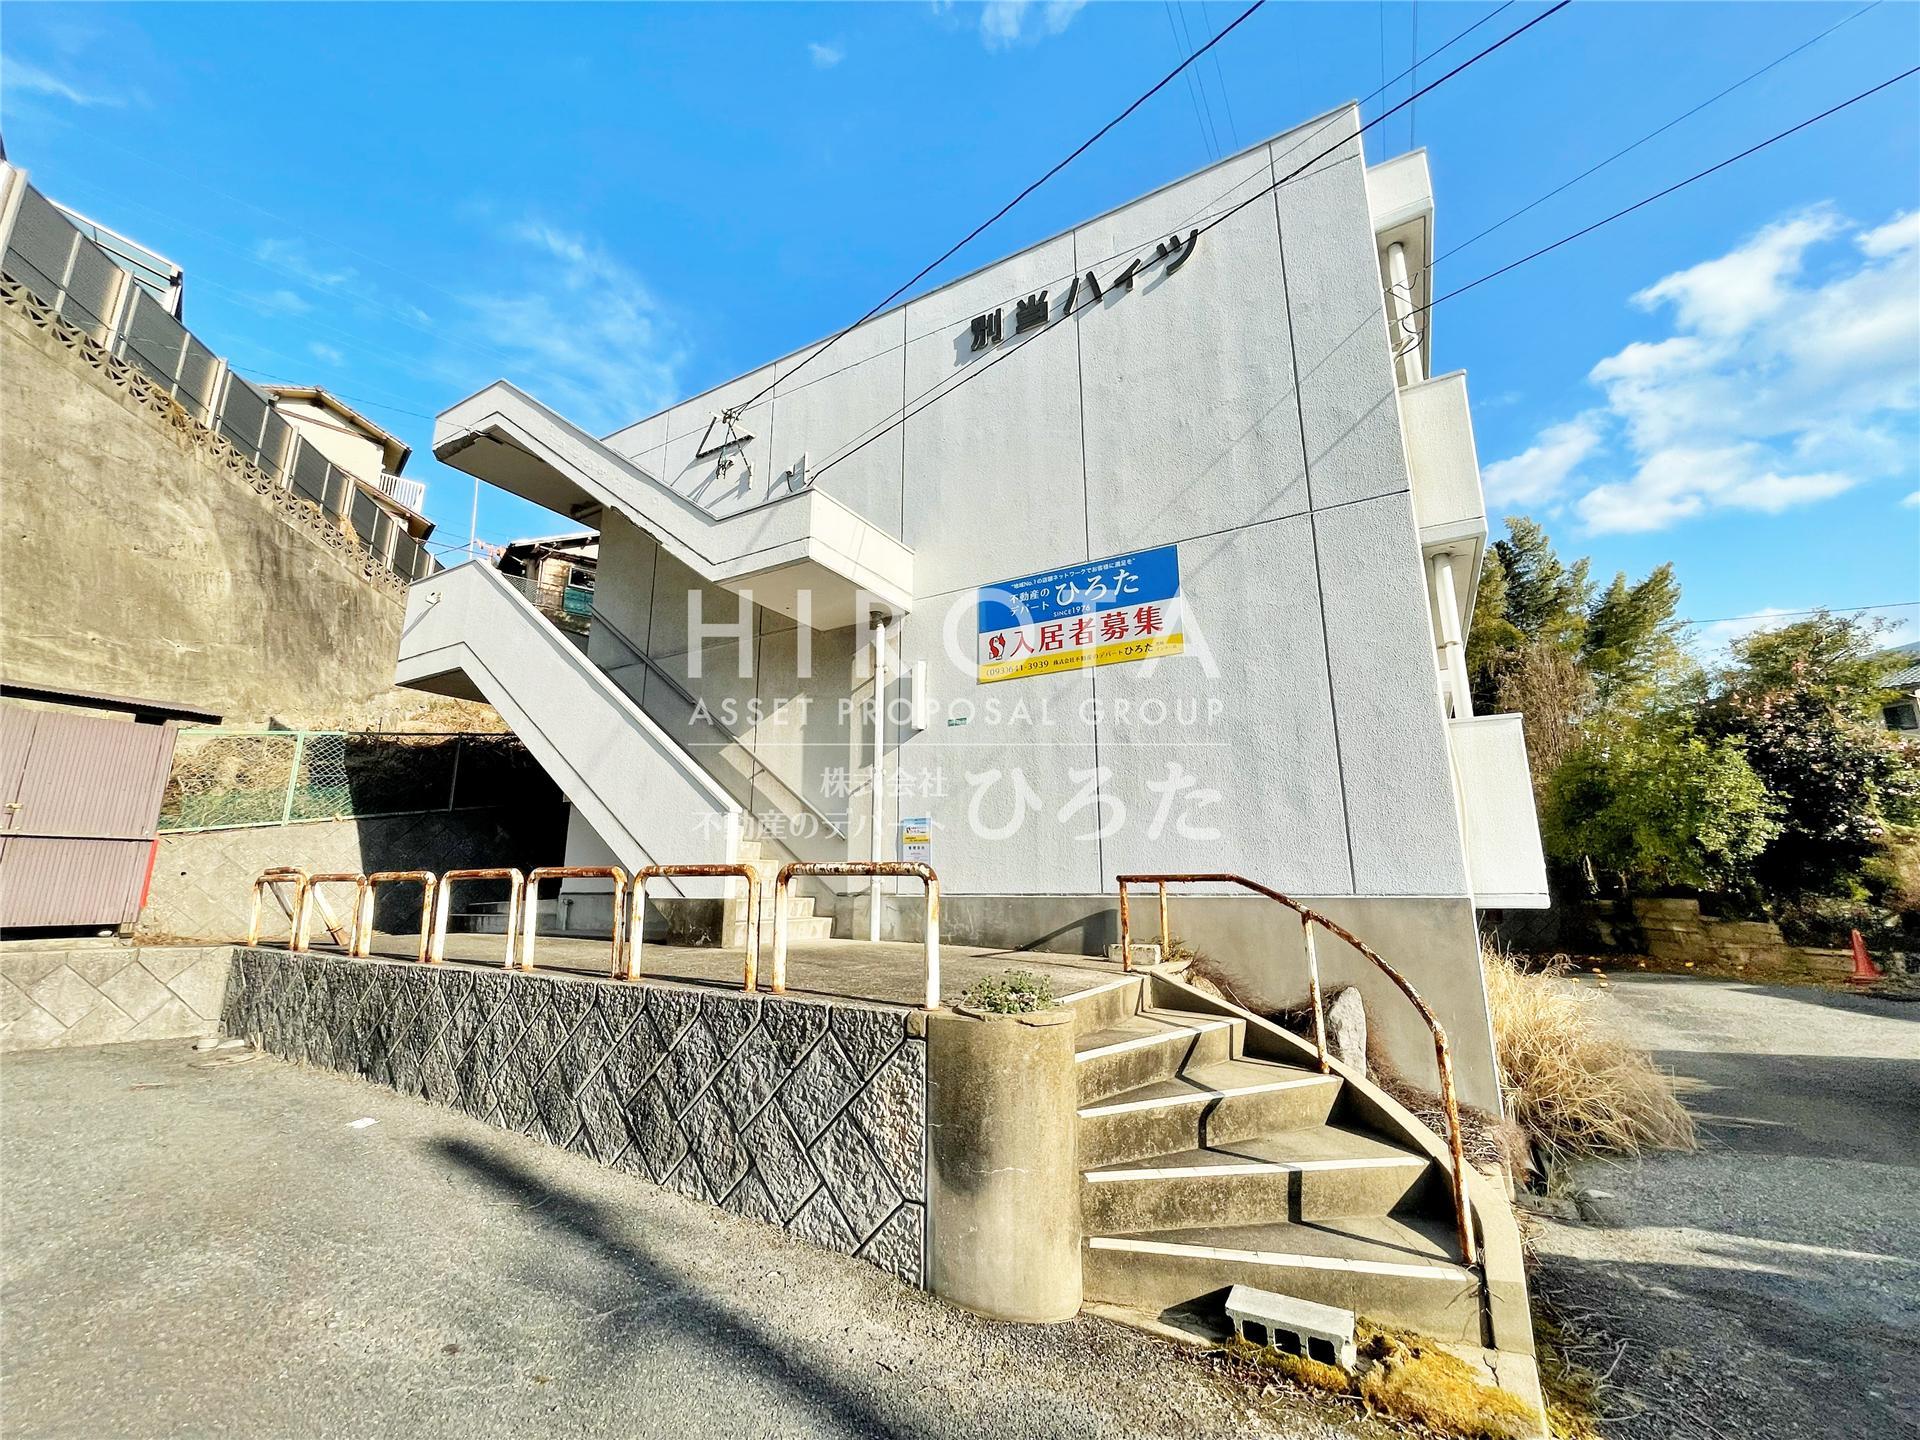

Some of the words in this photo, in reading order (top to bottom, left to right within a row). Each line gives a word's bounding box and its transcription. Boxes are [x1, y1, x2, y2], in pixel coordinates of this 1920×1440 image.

[1009, 587, 1049, 604] 不動産の
[1056, 567, 1139, 607] ひろた
[1010, 602, 1050, 617] デパート
[1010, 605, 1164, 658] 入居者募集
